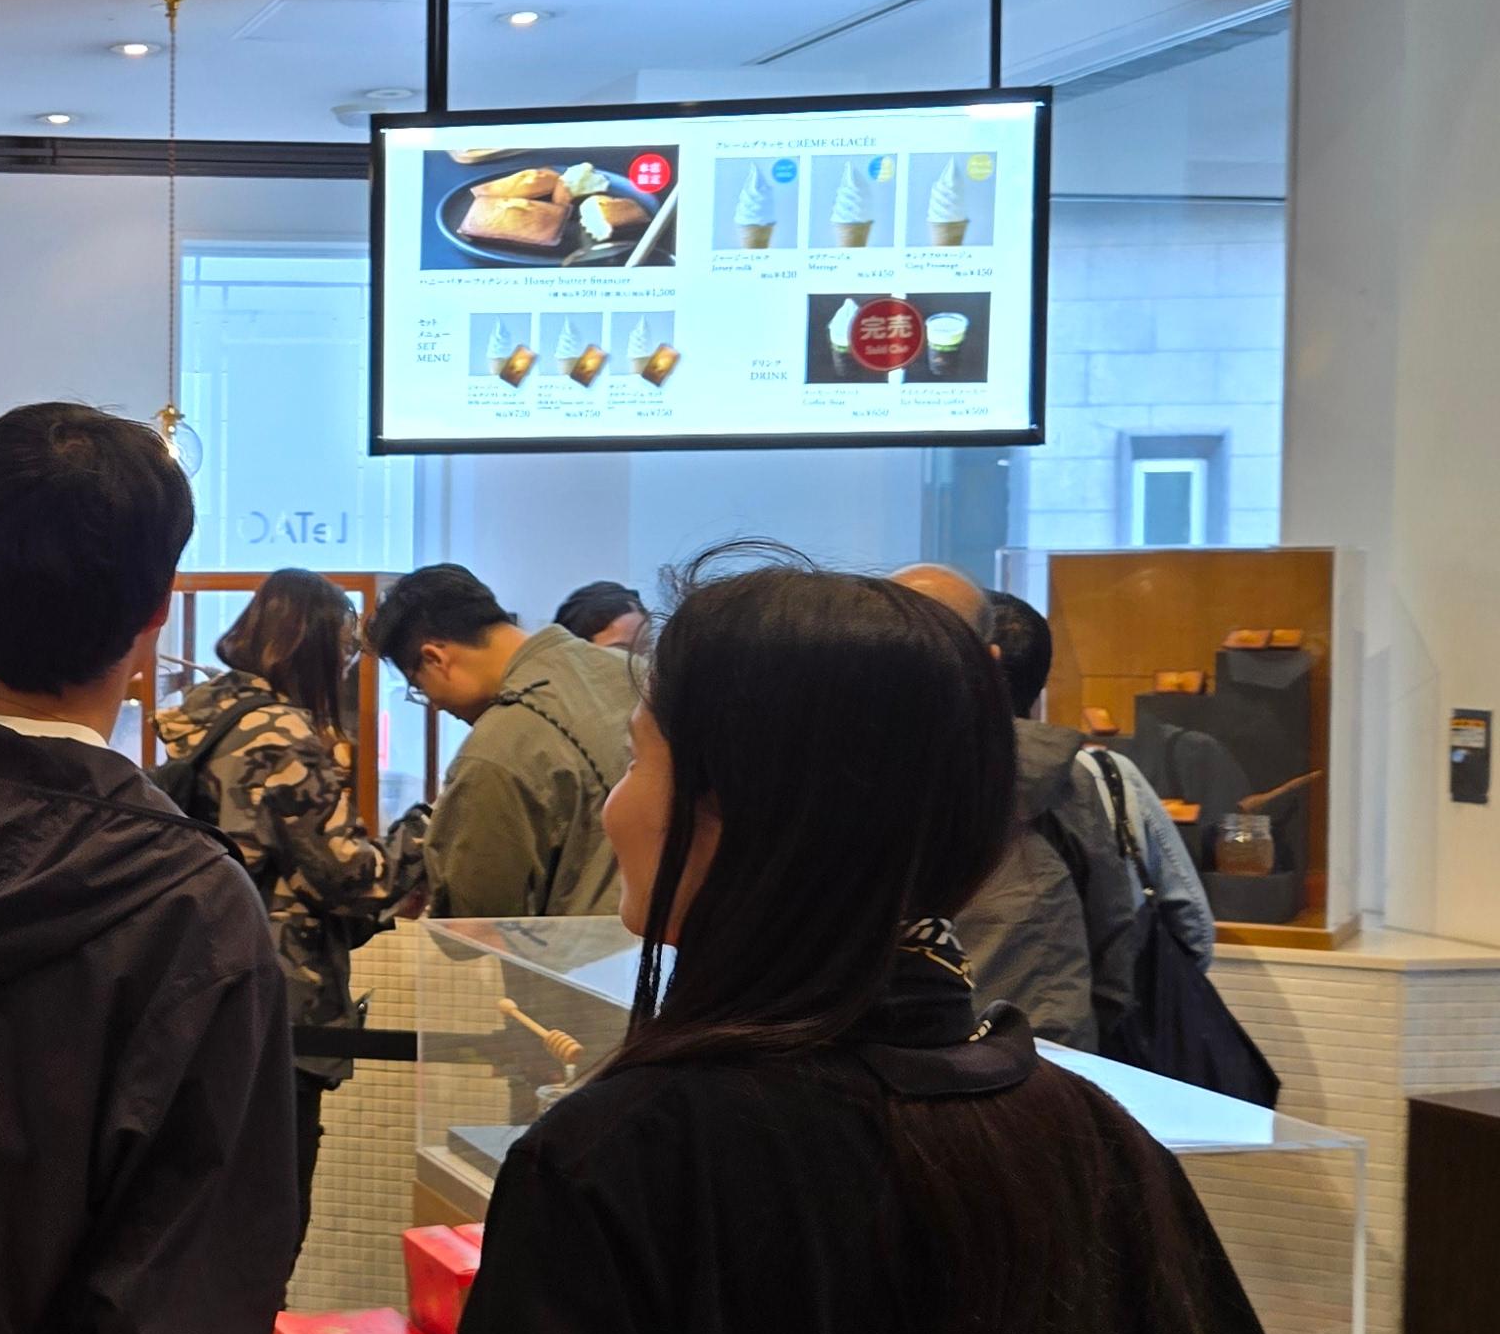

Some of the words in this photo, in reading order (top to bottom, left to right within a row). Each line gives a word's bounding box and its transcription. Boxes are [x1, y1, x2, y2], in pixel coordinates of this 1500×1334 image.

[860, 314, 912, 340] 完売
[417, 342, 437, 351] SET
[416, 353, 452, 363] MENU
[750, 371, 788, 380] DRINK
